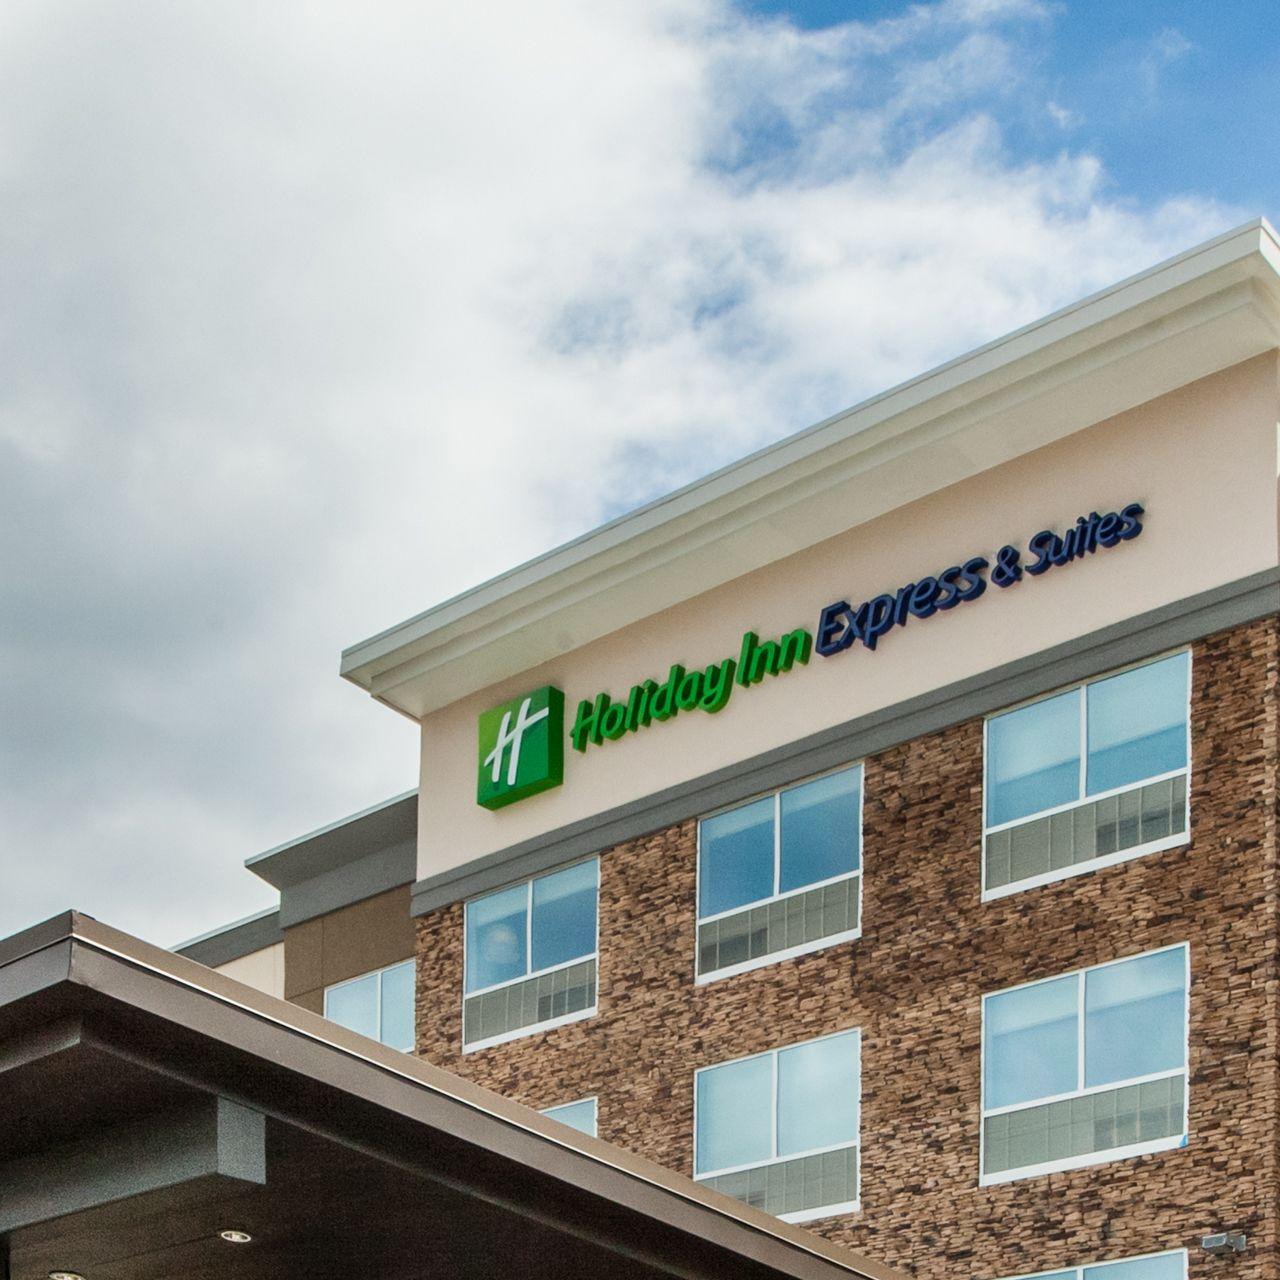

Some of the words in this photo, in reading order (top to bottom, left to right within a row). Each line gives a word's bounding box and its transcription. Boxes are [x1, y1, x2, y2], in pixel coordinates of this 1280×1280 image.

[570, 658, 737, 754] Holiday
[735, 628, 813, 689] Inn
[815, 556, 989, 658] Express
[990, 544, 1023, 589] &
[1024, 502, 1145, 577] Suites
